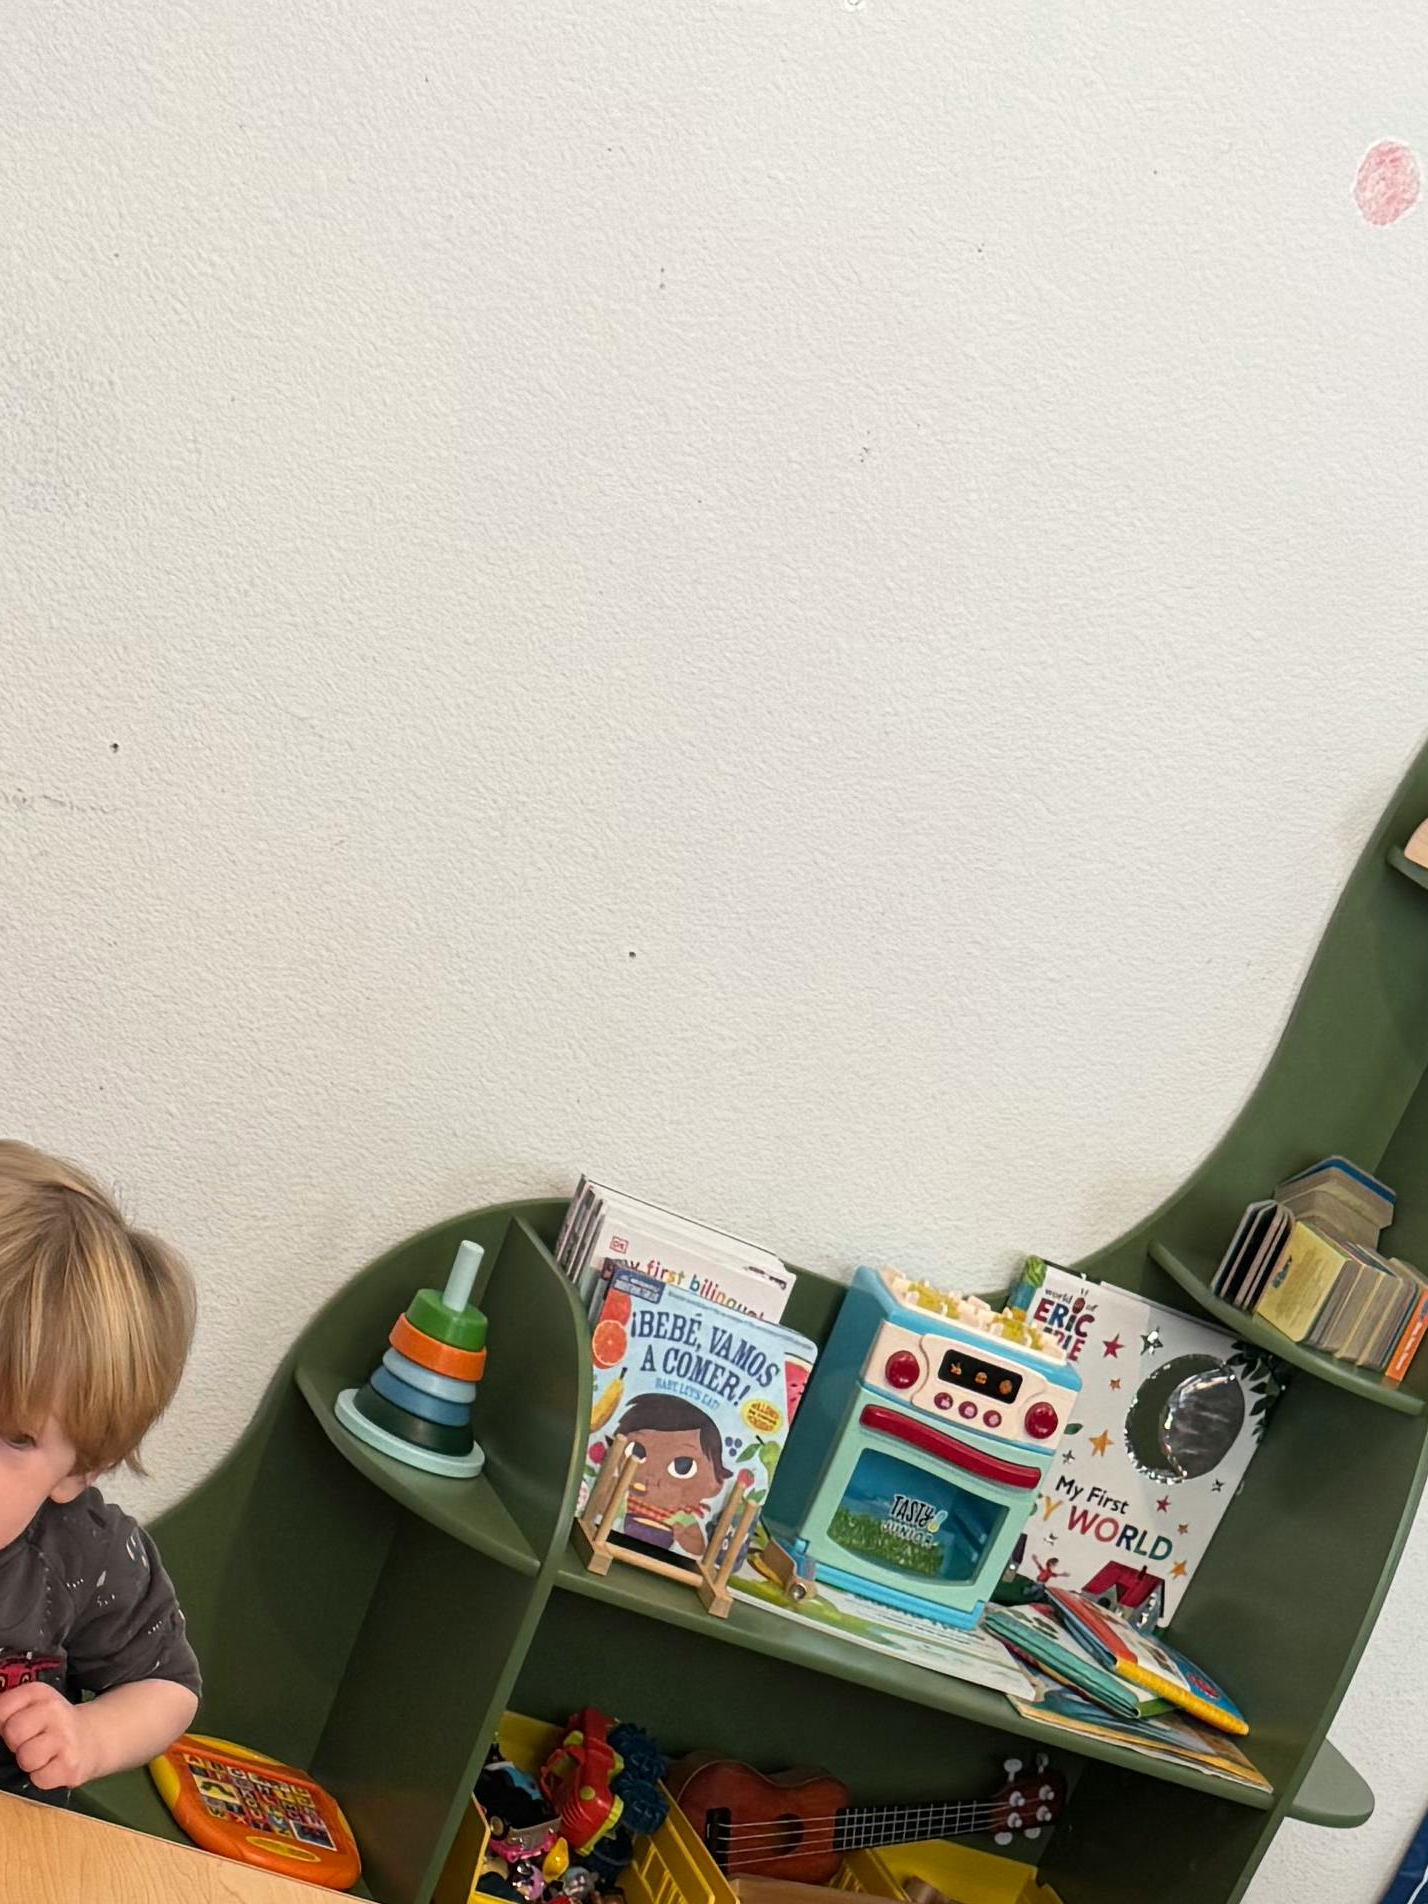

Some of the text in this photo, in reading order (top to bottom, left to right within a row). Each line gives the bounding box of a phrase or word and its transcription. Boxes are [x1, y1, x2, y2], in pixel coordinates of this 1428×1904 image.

[647, 1260, 685, 1285] first
[1033, 1297, 1096, 1339] ERIC
[631, 1309, 703, 1352] ¡BEBÉ,
[710, 1326, 780, 1389] VAMOS
[640, 1344, 752, 1407] A COMER!
[890, 1494, 935, 1528] TASTY
[1055, 1475, 1086, 1501] My
[1086, 1485, 1130, 1516] First
[1067, 1505, 1173, 1561] WORLD
